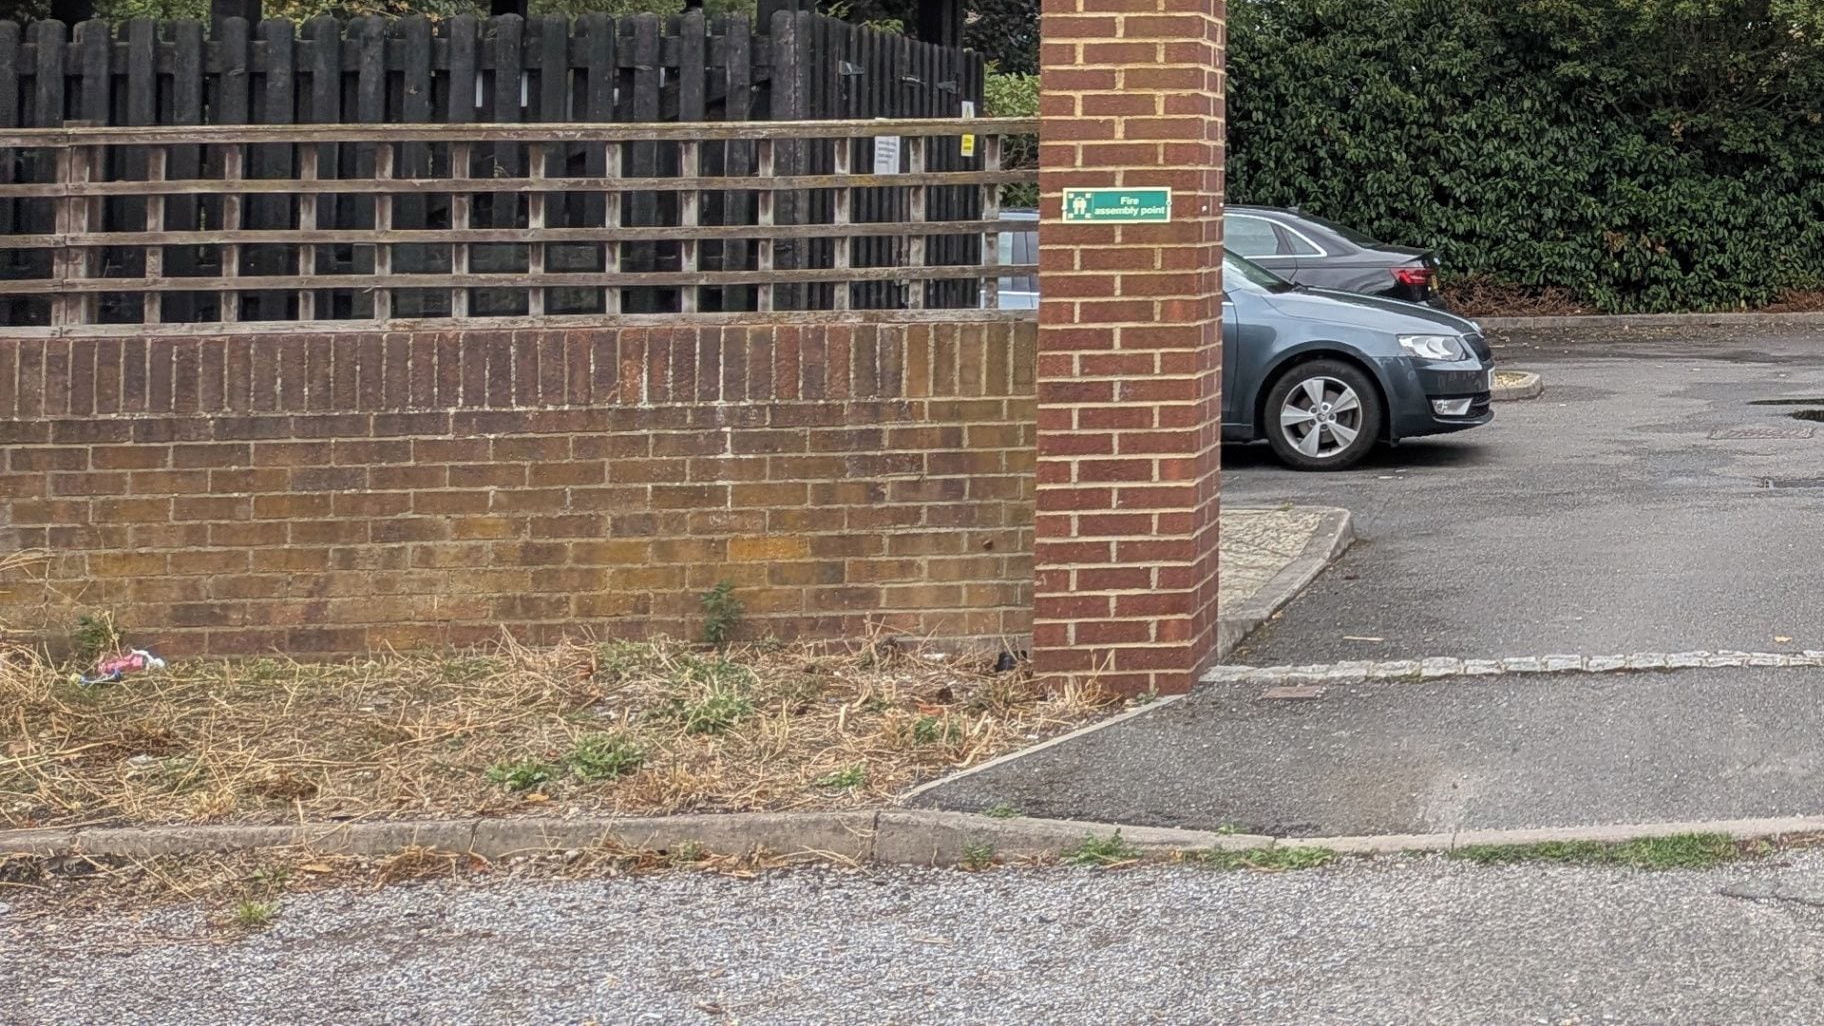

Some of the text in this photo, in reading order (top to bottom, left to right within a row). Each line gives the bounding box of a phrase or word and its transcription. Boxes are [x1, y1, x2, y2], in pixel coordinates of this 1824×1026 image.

[1120, 196, 1139, 205] Fire
[1094, 206, 1165, 216] assembly point
